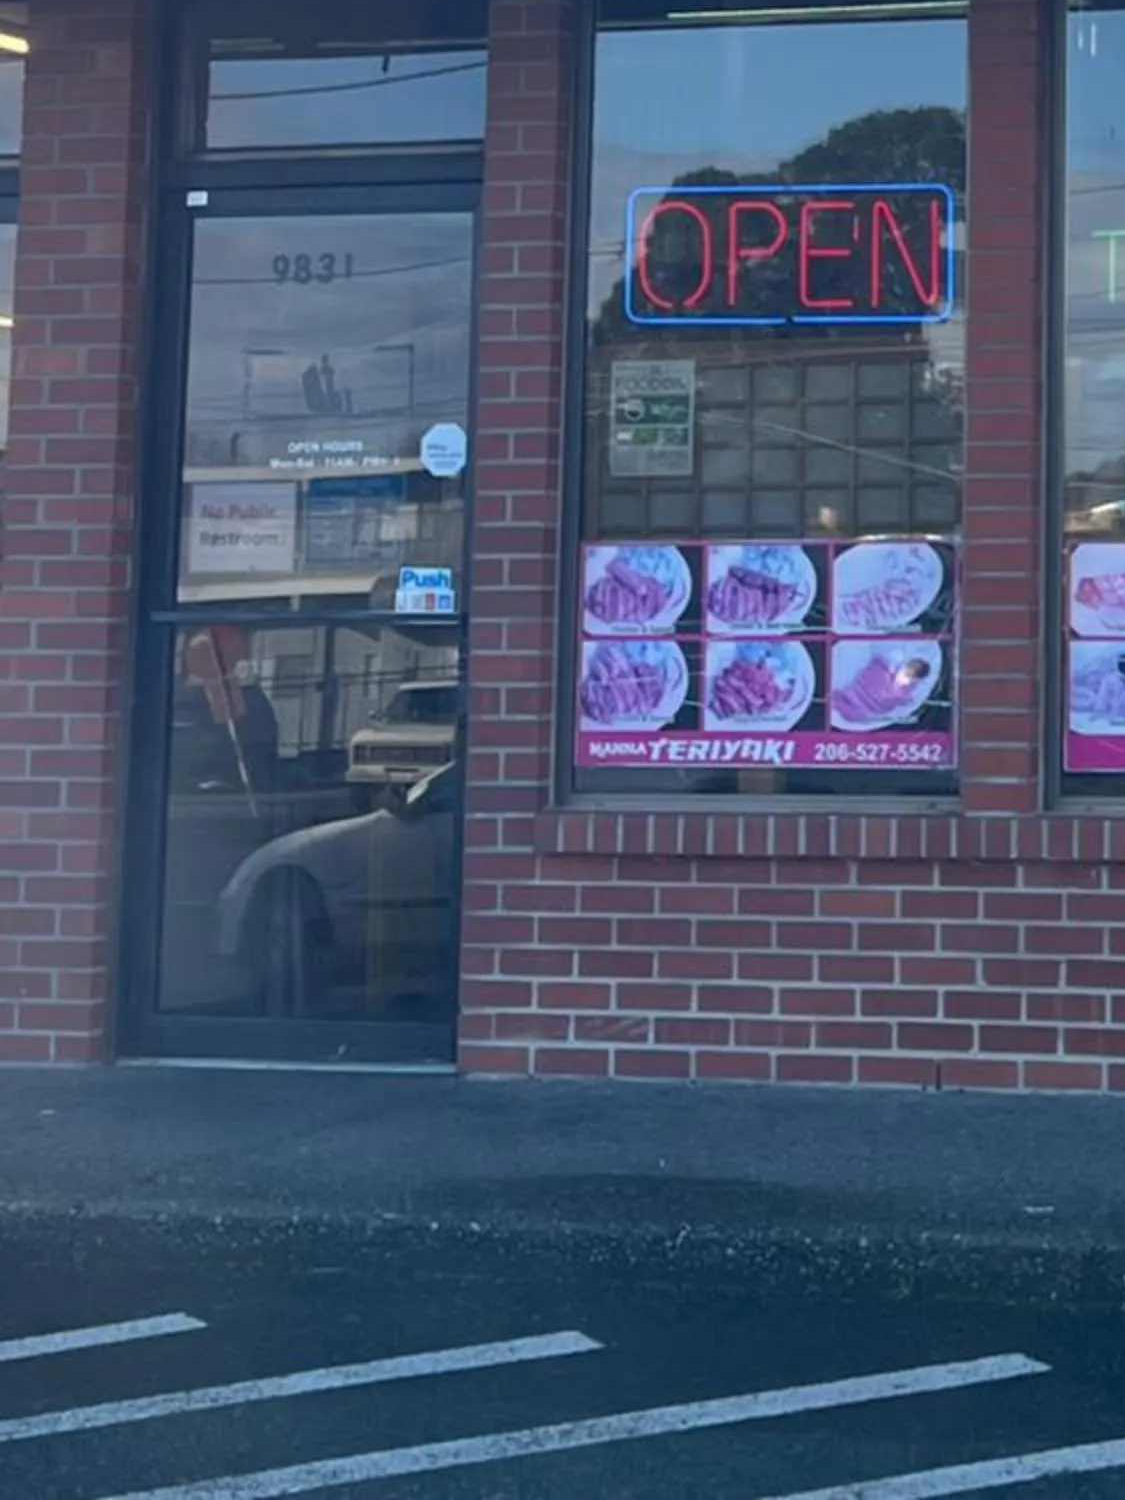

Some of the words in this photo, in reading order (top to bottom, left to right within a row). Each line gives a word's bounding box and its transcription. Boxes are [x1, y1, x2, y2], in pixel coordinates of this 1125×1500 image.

[272, 252, 353, 286] 9831
[636, 199, 941, 309] OPEN
[402, 570, 449, 588] Push
[588, 741, 648, 758] MANNA
[648, 737, 797, 766] TERIYAKI
